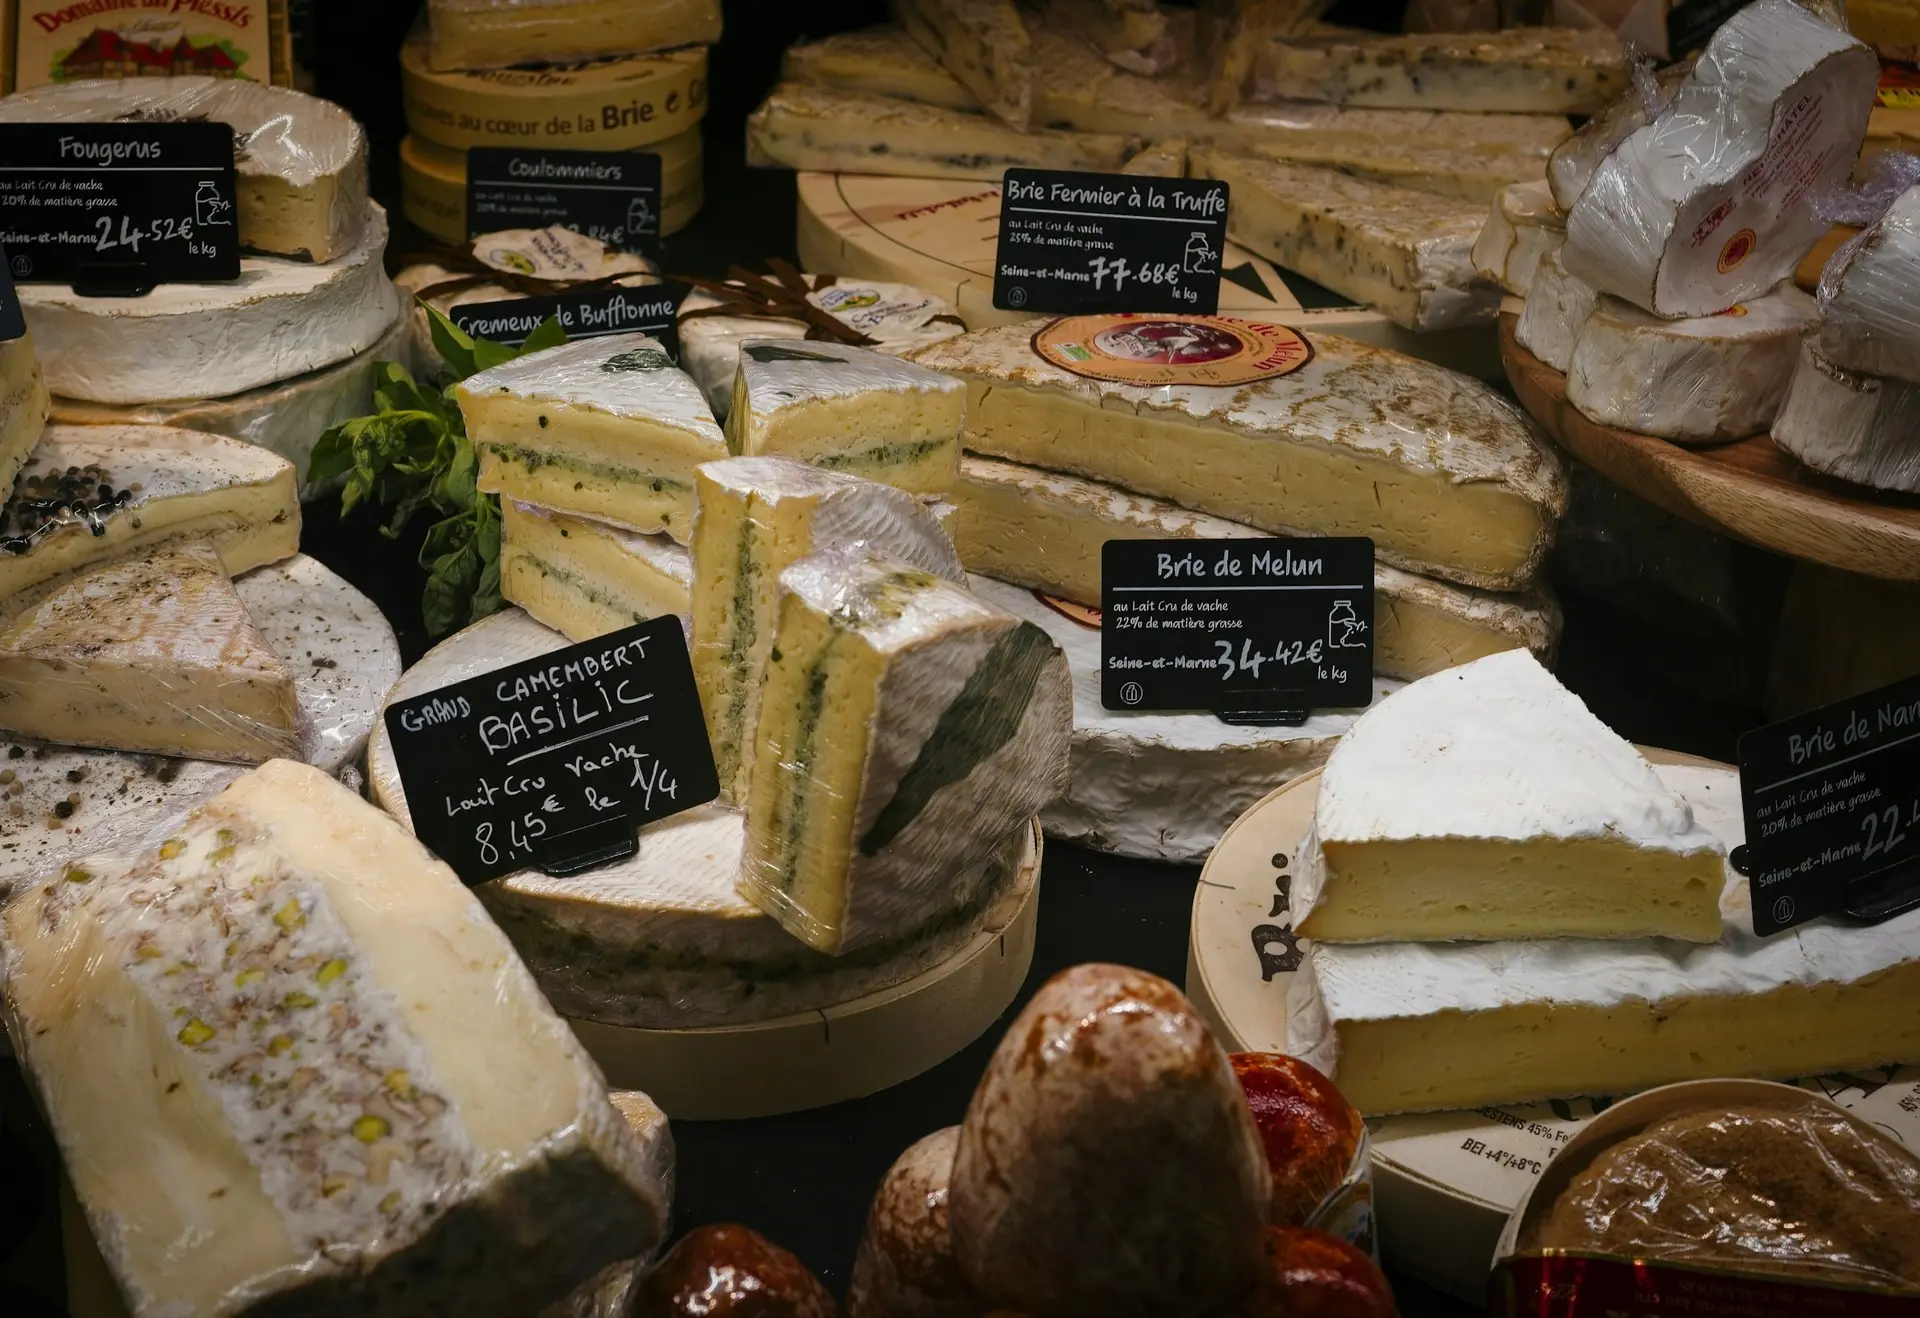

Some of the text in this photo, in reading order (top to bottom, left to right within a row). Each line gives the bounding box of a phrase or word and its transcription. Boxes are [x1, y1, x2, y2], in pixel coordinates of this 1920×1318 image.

[459, 114, 481, 132] au
[545, 116, 573, 135] de
[578, 114, 595, 132] la
[602, 99, 655, 130] Brie
[58, 136, 162, 167] Fougerus
[508, 156, 623, 181] Coulommiers
[28, 194, 42, 206] de
[59, 178, 72, 191] de
[73, 178, 104, 191] vache
[1008, 179, 1226, 217] Brie Fermier à la Truffe
[95, 215, 194, 252] 24.52€
[1008, 219, 1021, 229] au
[1024, 219, 1043, 230] Lait
[1063, 221, 1075, 233] de
[1033, 233, 1045, 246] de
[189, 242, 217, 259] le kg
[1000, 256, 1180, 292] Seine-et-Marne 77.68€
[1172, 286, 1198, 303] le kg
[457, 314, 544, 336] Cremeux
[579, 294, 675, 328] Bufflonne
[1156, 550, 1323, 579] Brie de Melun
[1113, 598, 1229, 612] au Lait Cru de vache
[1115, 616, 1244, 633] 22% de matière grasse
[1108, 638, 1323, 681] Seine-et-Marne 34.42€
[1317, 665, 1347, 683] le kg
[401, 635, 651, 732] GRAND CAMEMBERT
[1788, 725, 1837, 766] Brie
[1842, 710, 1870, 745] de
[446, 778, 499, 817] Lait
[585, 786, 621, 811] le
[631, 758, 678, 811] 1/4
[1757, 769, 1867, 819] au Lait Cru de vache
[1761, 787, 1882, 838] 20% de matière grasse
[1758, 841, 1862, 888] Seine-et-Marne
[1527, 1123, 1552, 1139] 45%
[1460, 1138, 1486, 1156] BEI
